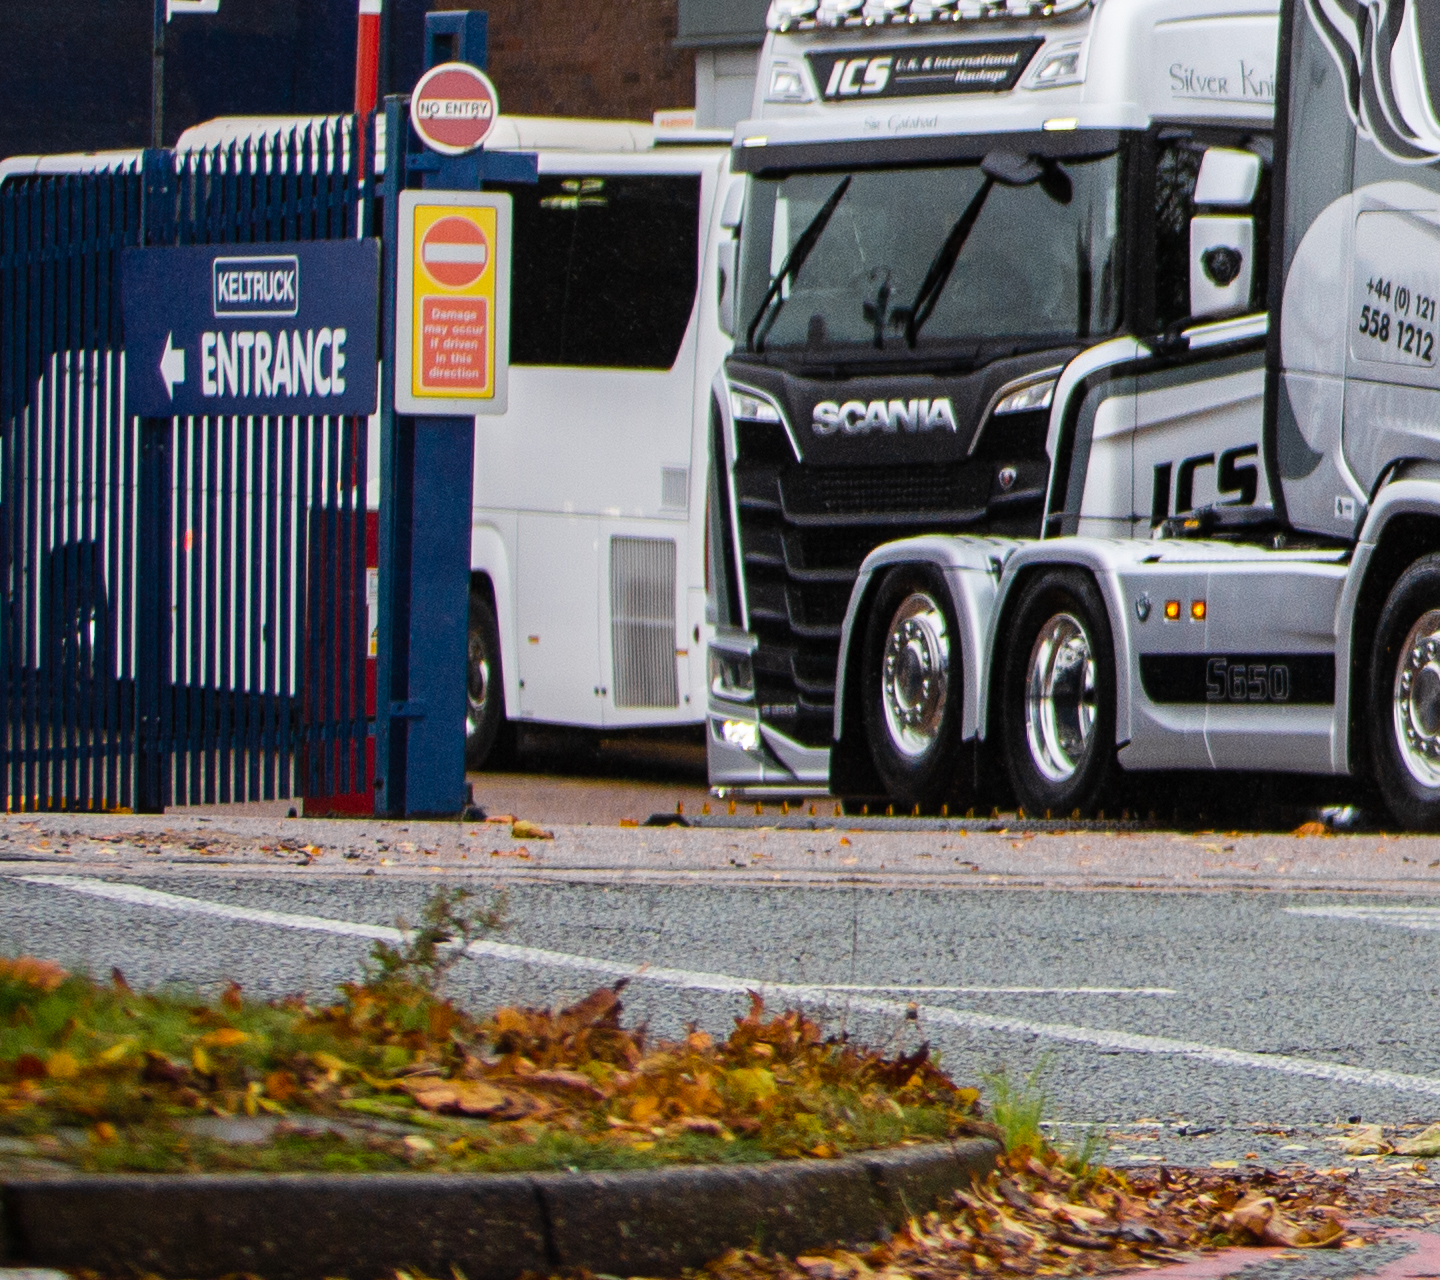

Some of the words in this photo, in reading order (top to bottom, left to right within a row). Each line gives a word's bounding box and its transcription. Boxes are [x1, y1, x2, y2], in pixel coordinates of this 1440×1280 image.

[933, 51, 1019, 70] International
[824, 56, 893, 98] ICS
[954, 68, 1008, 85] Haulage
[1169, 63, 1229, 94] Silver
[421, 101, 440, 115] NO
[445, 101, 487, 115] ENTRY
[218, 270, 295, 303] KELTRUCK
[1366, 277, 1391, 302] +44
[1394, 285, 1411, 316] (0)
[1416, 295, 1436, 322] 121
[424, 324, 448, 335] may
[452, 325, 484, 335] occur
[431, 308, 477, 322] Damage
[443, 338, 478, 350] driven
[1358, 305, 1390, 342] 558
[1397, 320, 1434, 361] 1212
[201, 326, 347, 398] ENTRANCE
[428, 367, 479, 379] direction
[435, 352, 446, 364] in
[450, 352, 472, 364] this
[812, 397, 957, 435] SCANIA
[1150, 443, 1258, 529] ICS
[1206, 657, 1289, 700] S650
